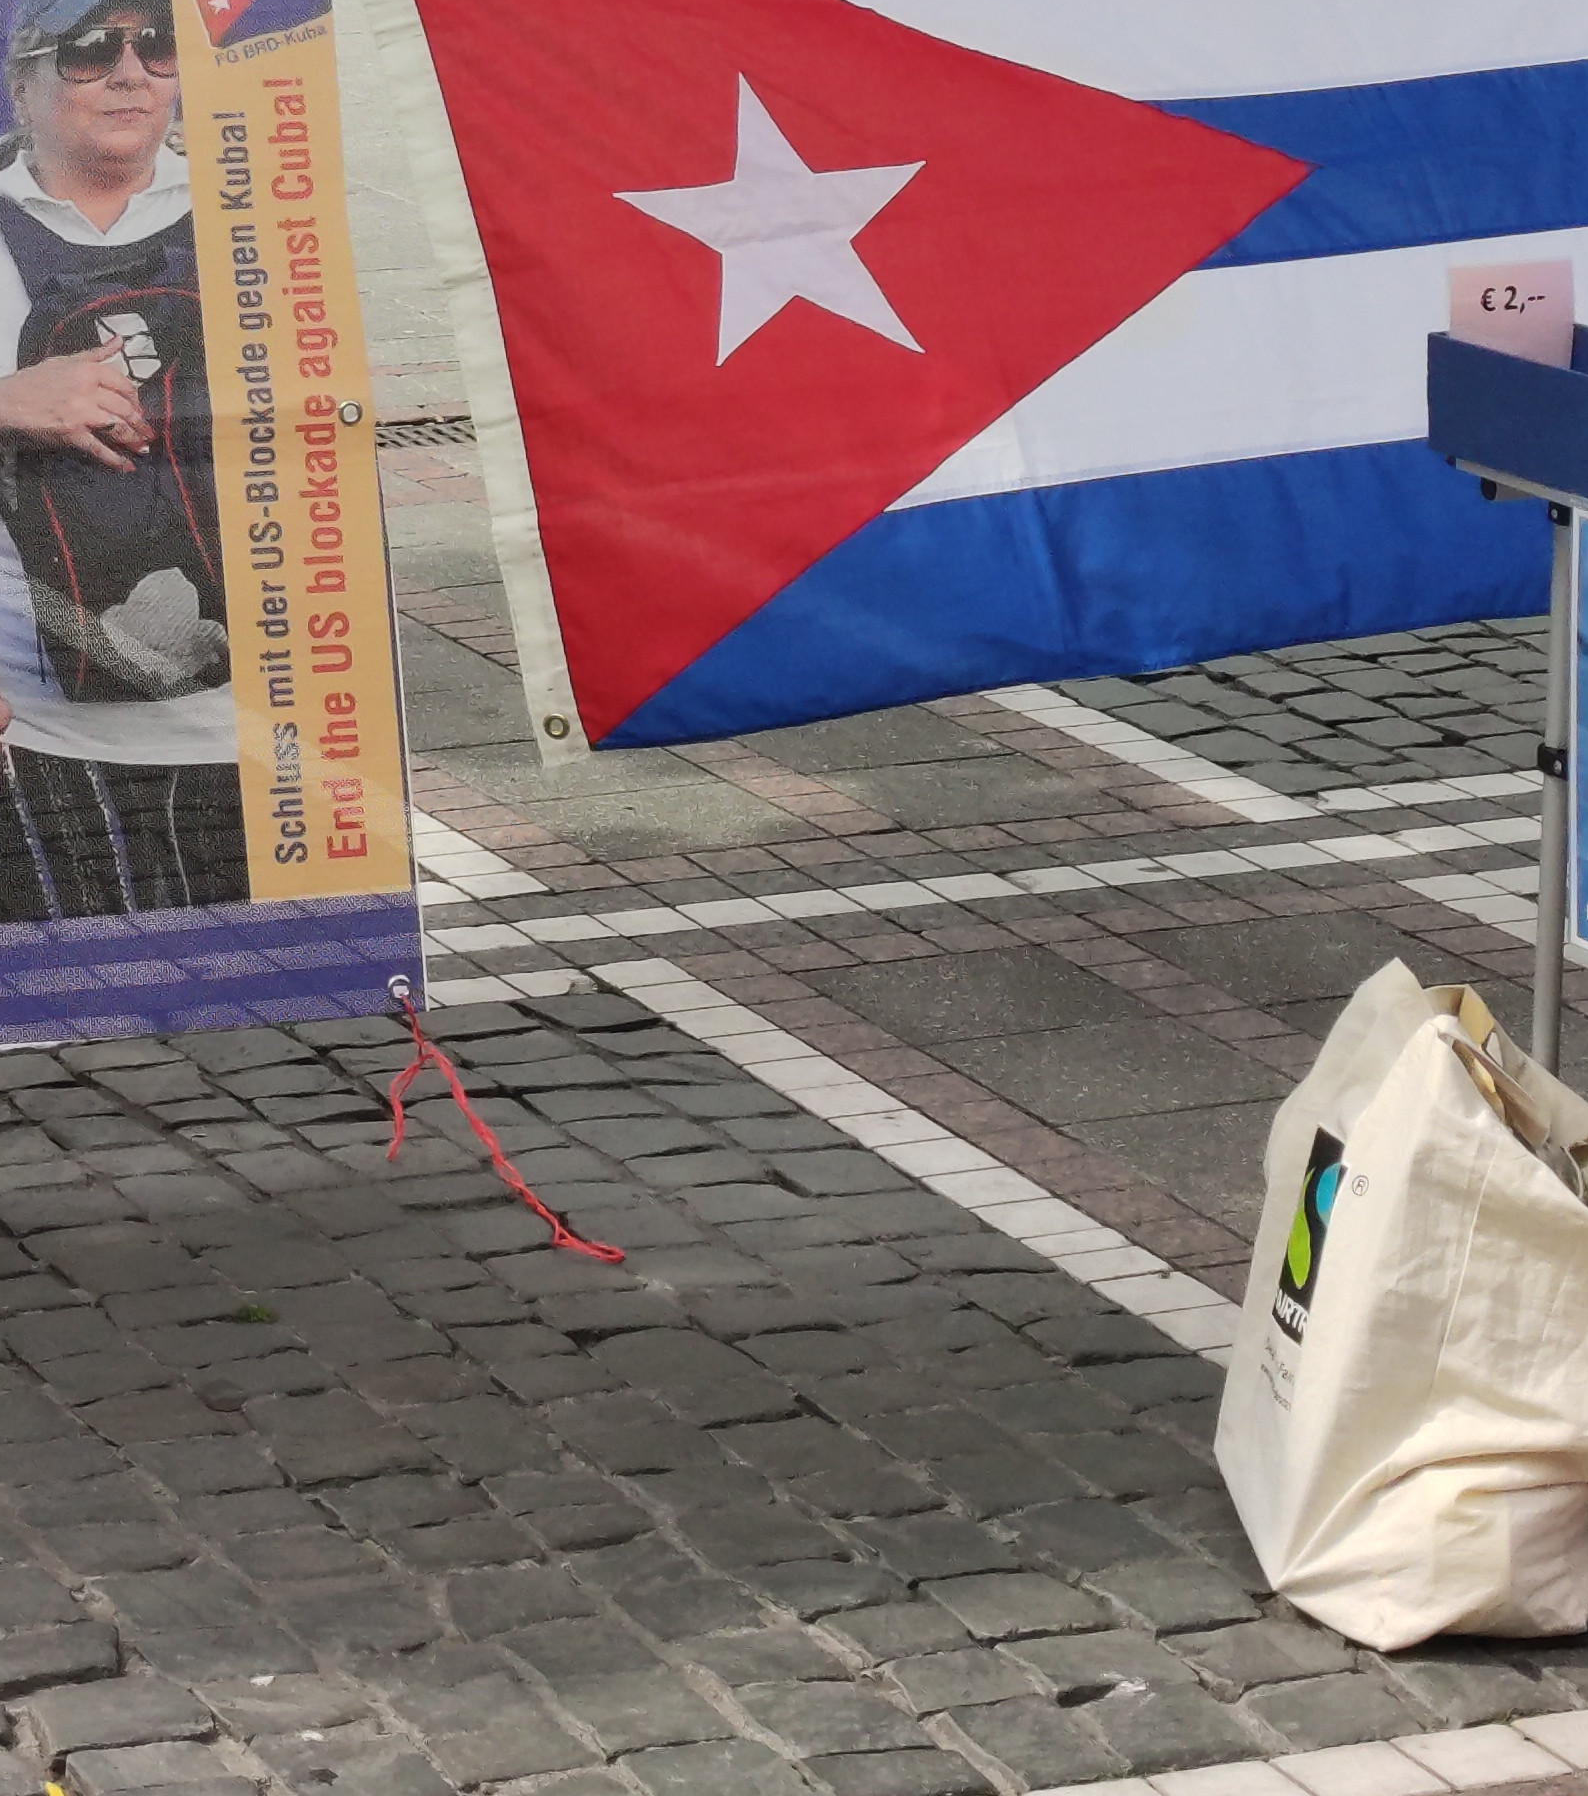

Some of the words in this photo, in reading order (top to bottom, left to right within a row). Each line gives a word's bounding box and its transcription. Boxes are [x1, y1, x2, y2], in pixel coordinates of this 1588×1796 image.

[214, 48, 240, 68] FG
[212, 110, 254, 211] Kuba!
[262, 77, 314, 201] Cuba!
[230, 224, 273, 331] gegen
[276, 216, 339, 379] against
[1480, 288, 1496, 312] €
[235, 342, 285, 570] US-Blockade
[294, 393, 348, 594] blockade
[256, 580, 290, 638] der
[307, 610, 354, 675] US
[259, 648, 295, 709] mit
[318, 692, 360, 761] the
[273, 722, 308, 865] Schluss
[321, 776, 369, 860] End
